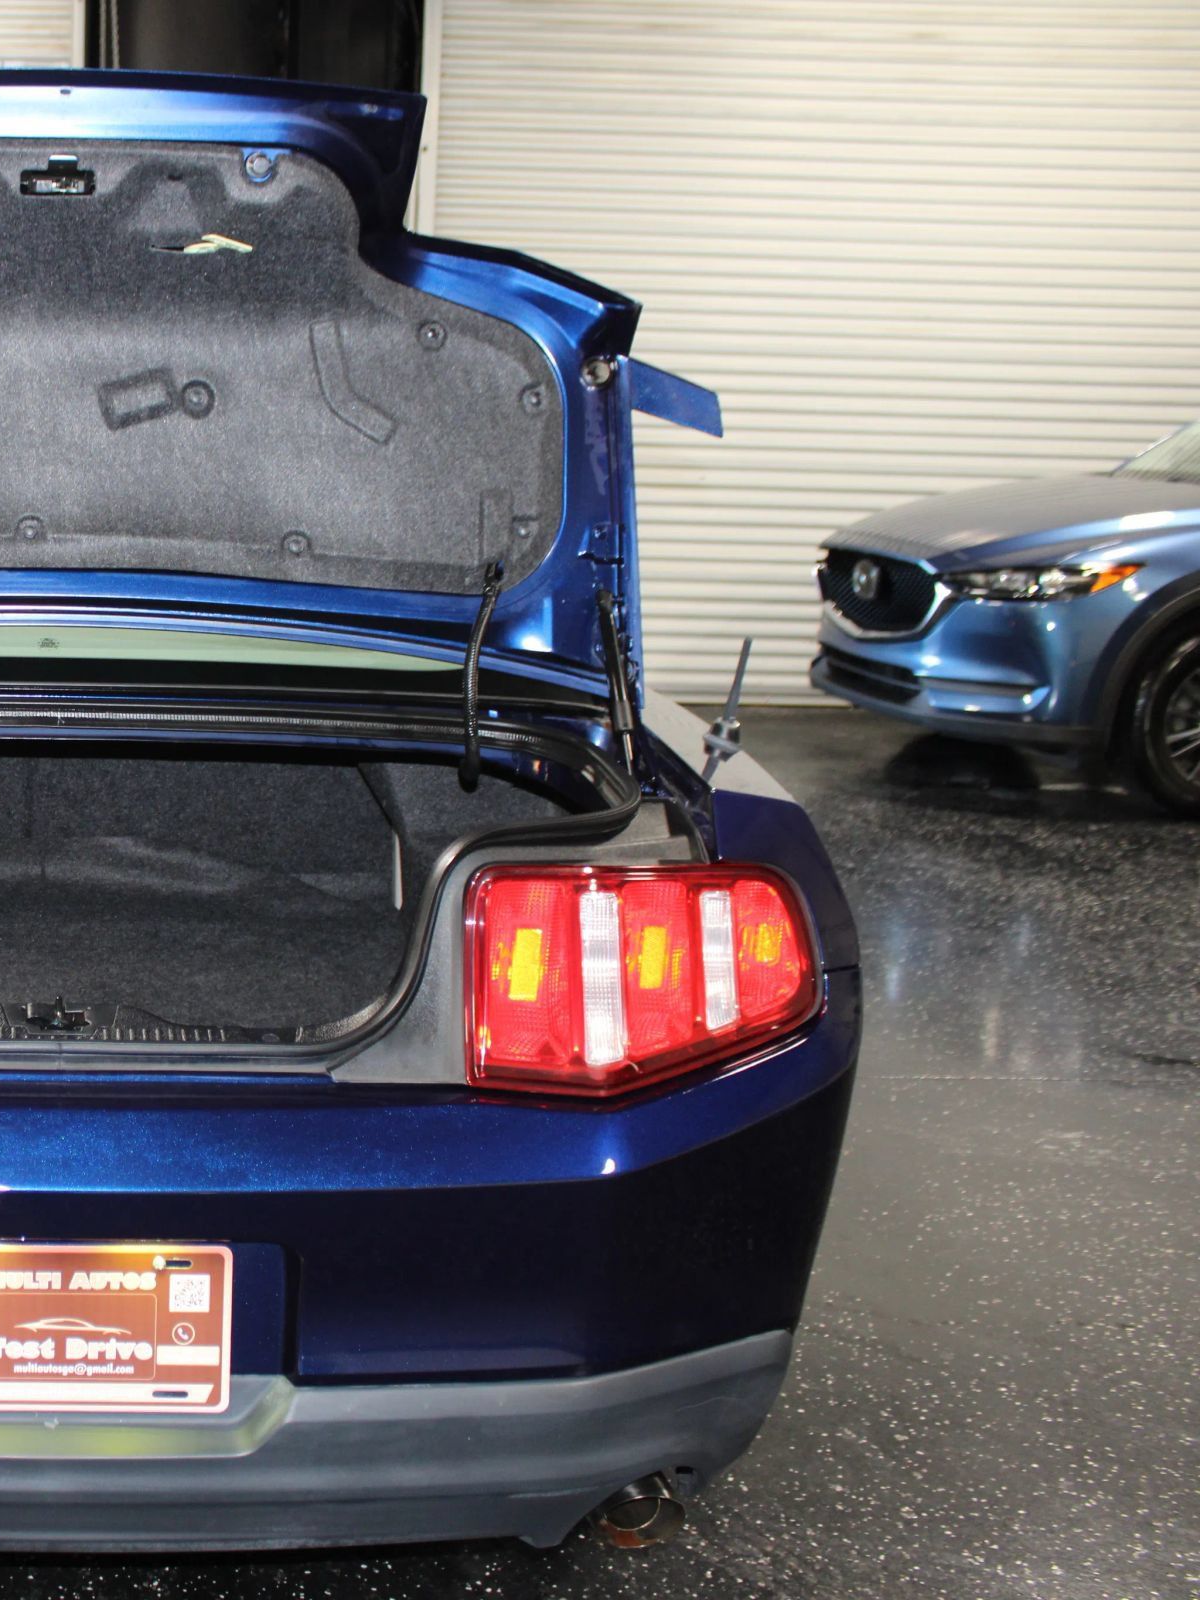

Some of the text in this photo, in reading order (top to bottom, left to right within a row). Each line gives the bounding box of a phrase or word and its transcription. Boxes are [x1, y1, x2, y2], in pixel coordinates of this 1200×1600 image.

[68, 1272, 157, 1290] AUTOS
[65, 1337, 153, 1360] Drive
[13, 1362, 134, 1376] multiautosga@gmail.com
